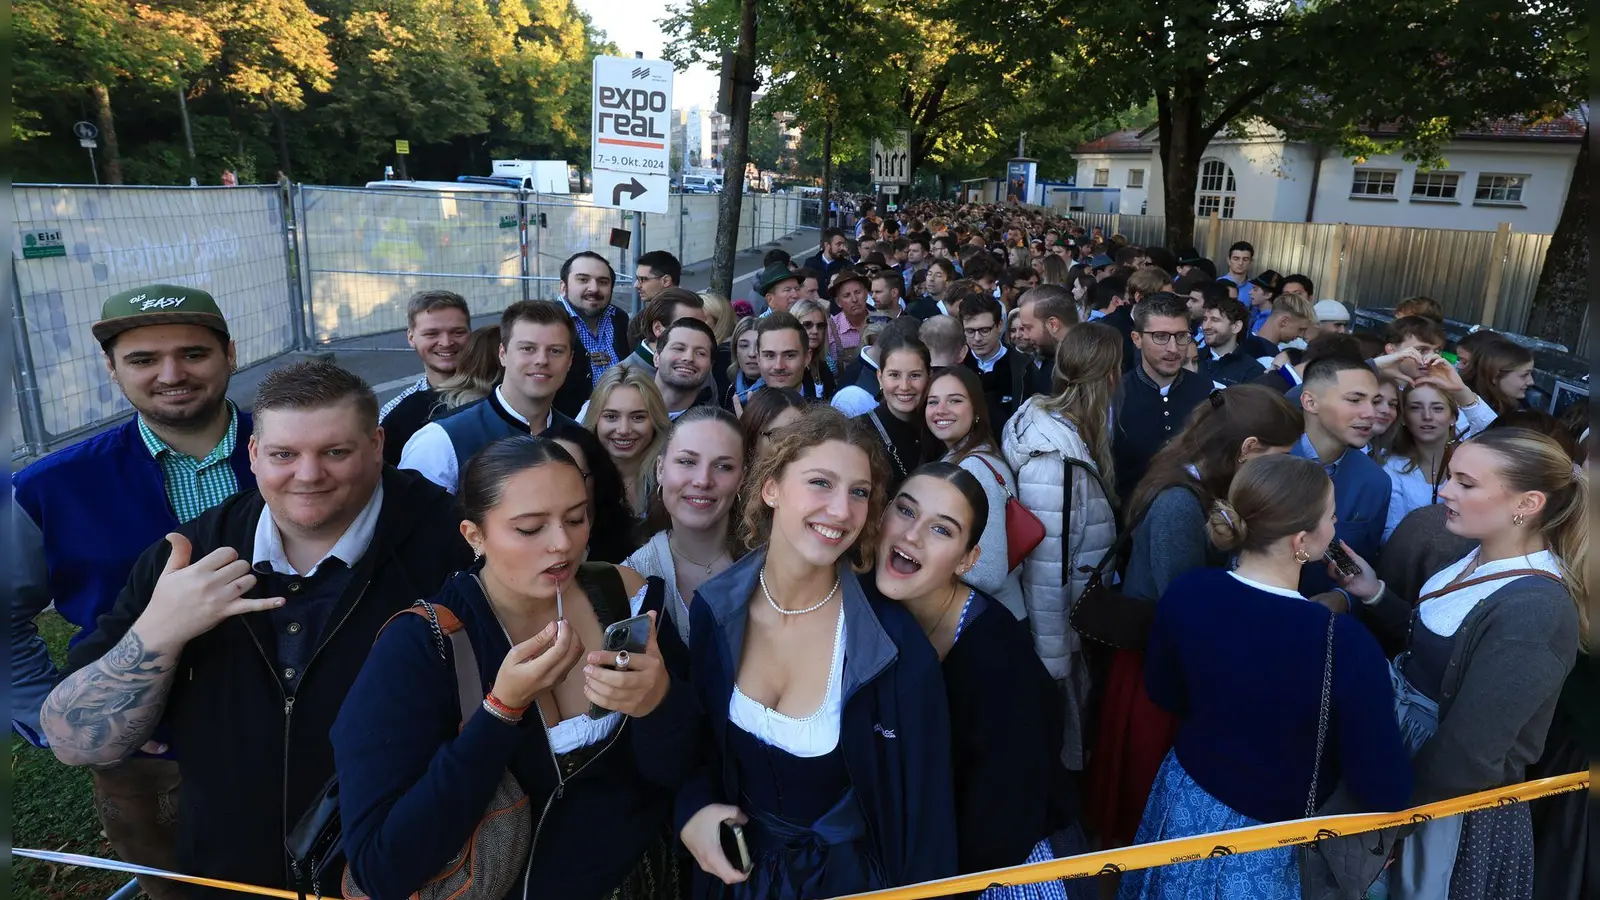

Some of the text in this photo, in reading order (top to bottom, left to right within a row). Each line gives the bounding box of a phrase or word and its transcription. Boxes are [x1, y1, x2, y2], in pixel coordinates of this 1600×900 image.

[599, 86, 667, 120] expo
[621, 156, 641, 167] Okt.
[642, 158, 664, 169] 2024
[38, 231, 60, 241] Eisl
[140, 296, 187, 311] EASY
